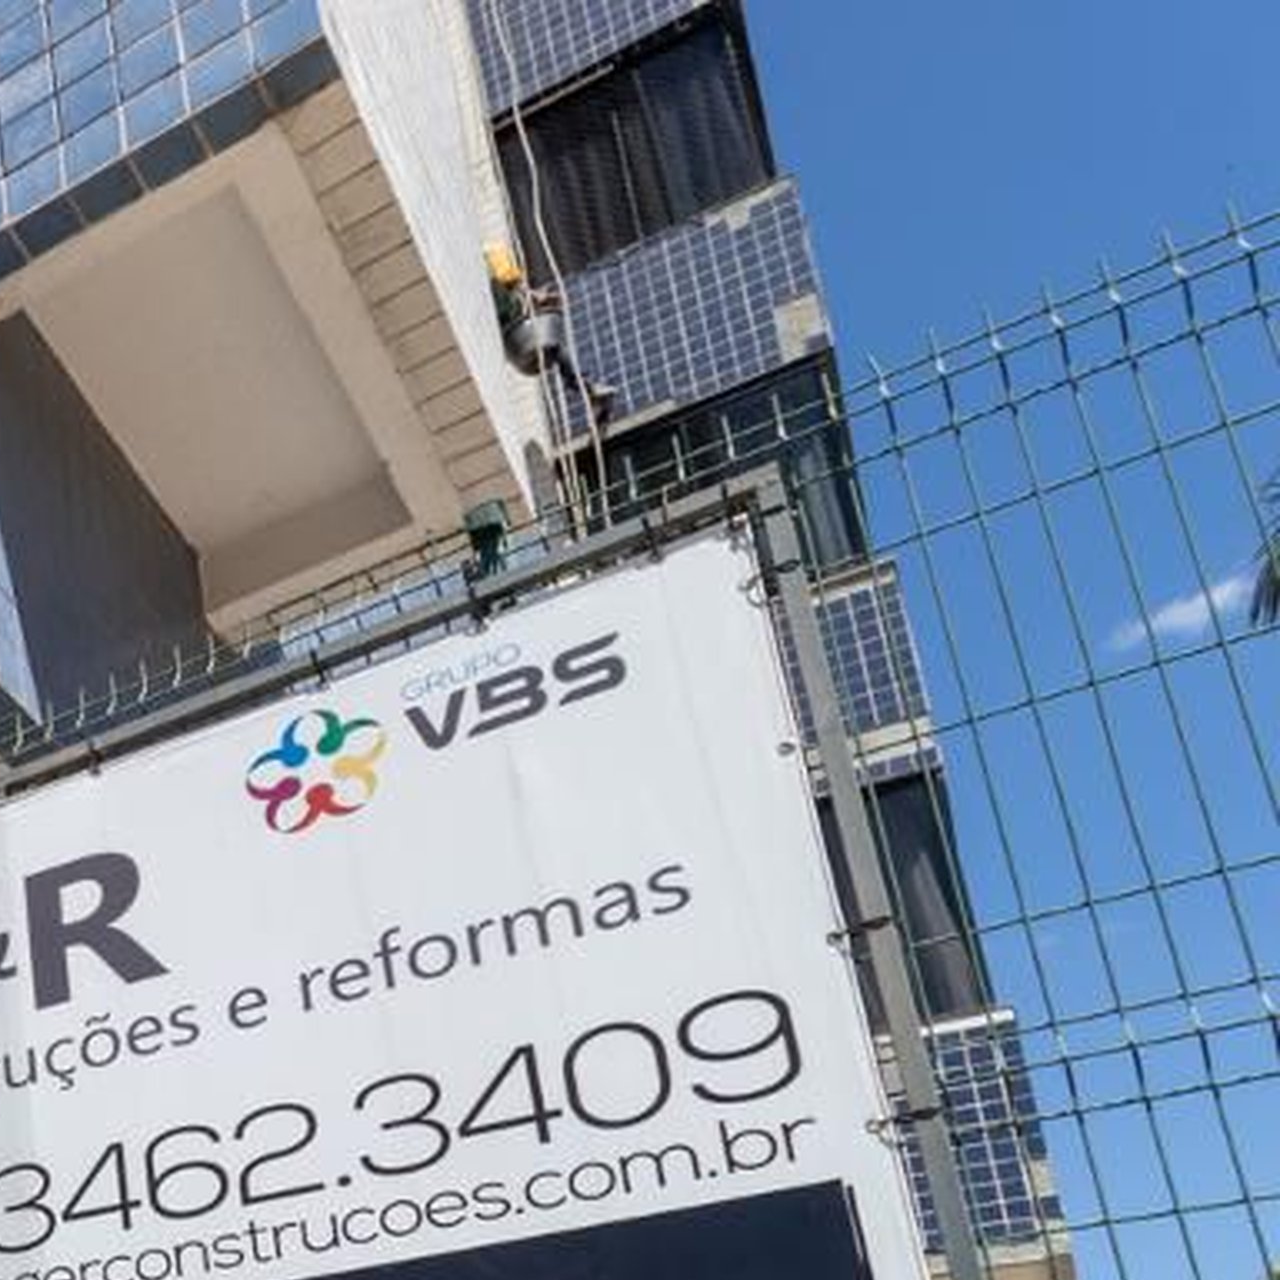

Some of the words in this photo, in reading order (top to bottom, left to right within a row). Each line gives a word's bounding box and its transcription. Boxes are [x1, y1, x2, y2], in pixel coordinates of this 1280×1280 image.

[402, 643, 522, 699] GRUPO
[405, 632, 627, 750] VBS
[228, 986, 268, 1028] e
[298, 864, 691, 1011] reformas
